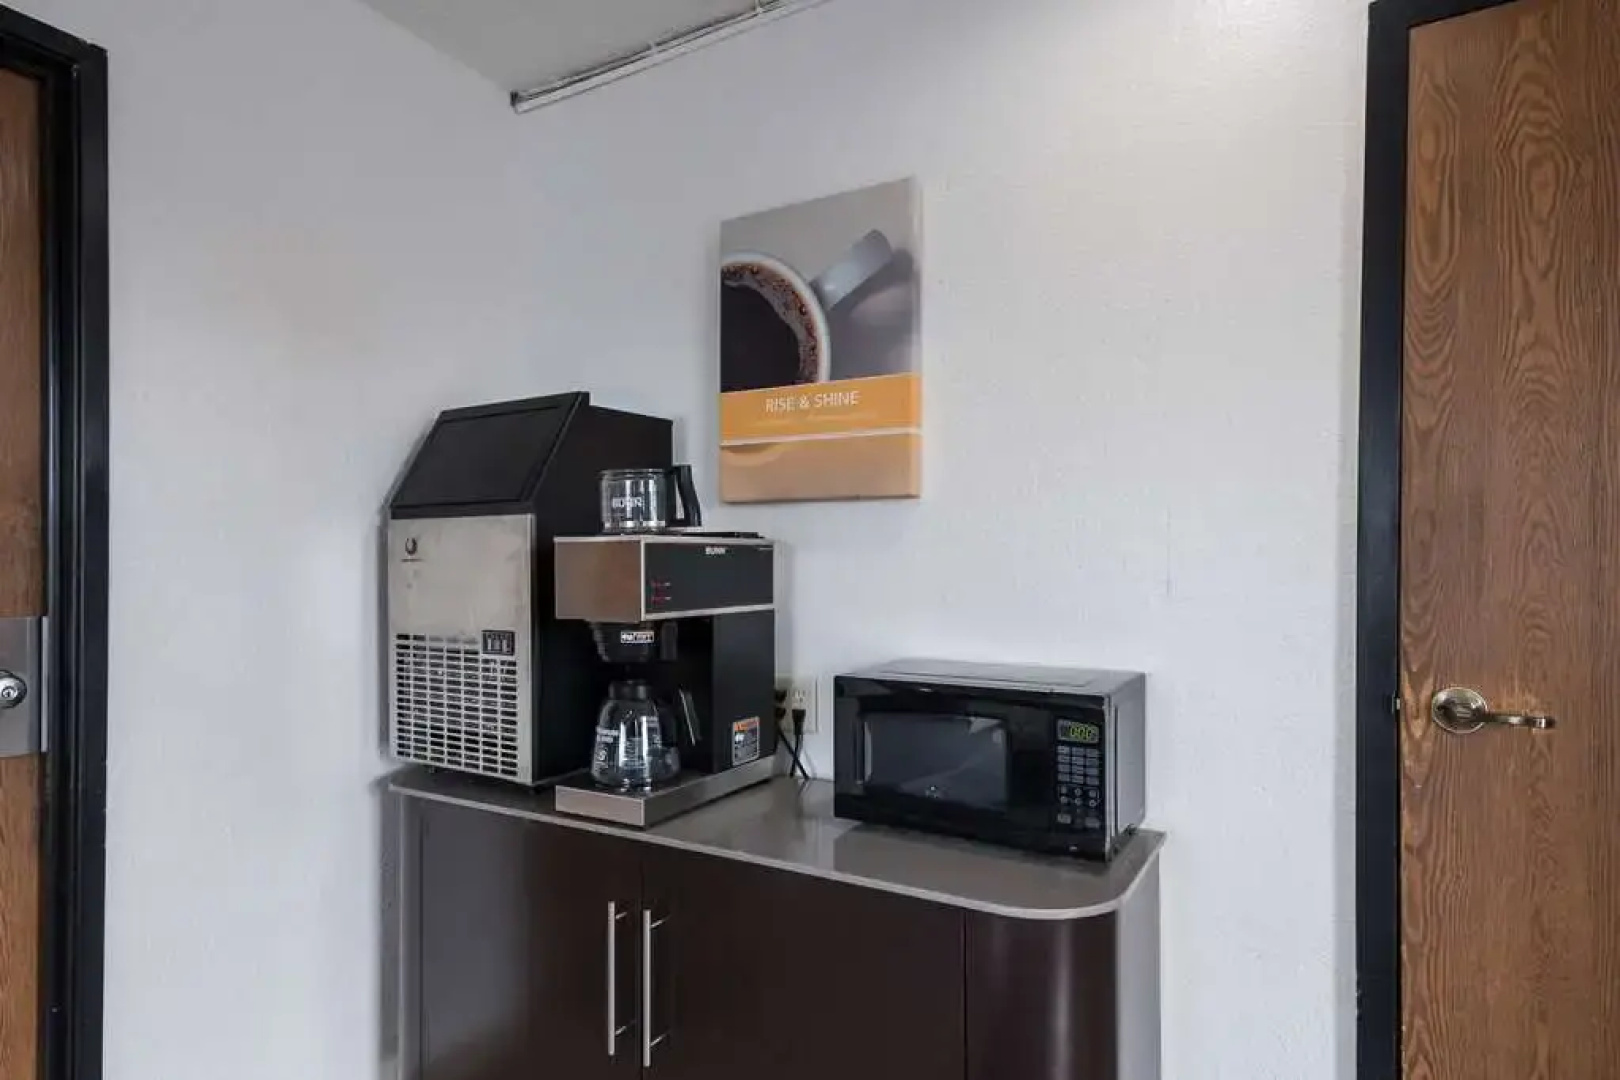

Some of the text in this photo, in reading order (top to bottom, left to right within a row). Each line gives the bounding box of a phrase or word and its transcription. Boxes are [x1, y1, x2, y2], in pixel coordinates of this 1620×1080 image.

[765, 391, 860, 412] RISE & SHINE
